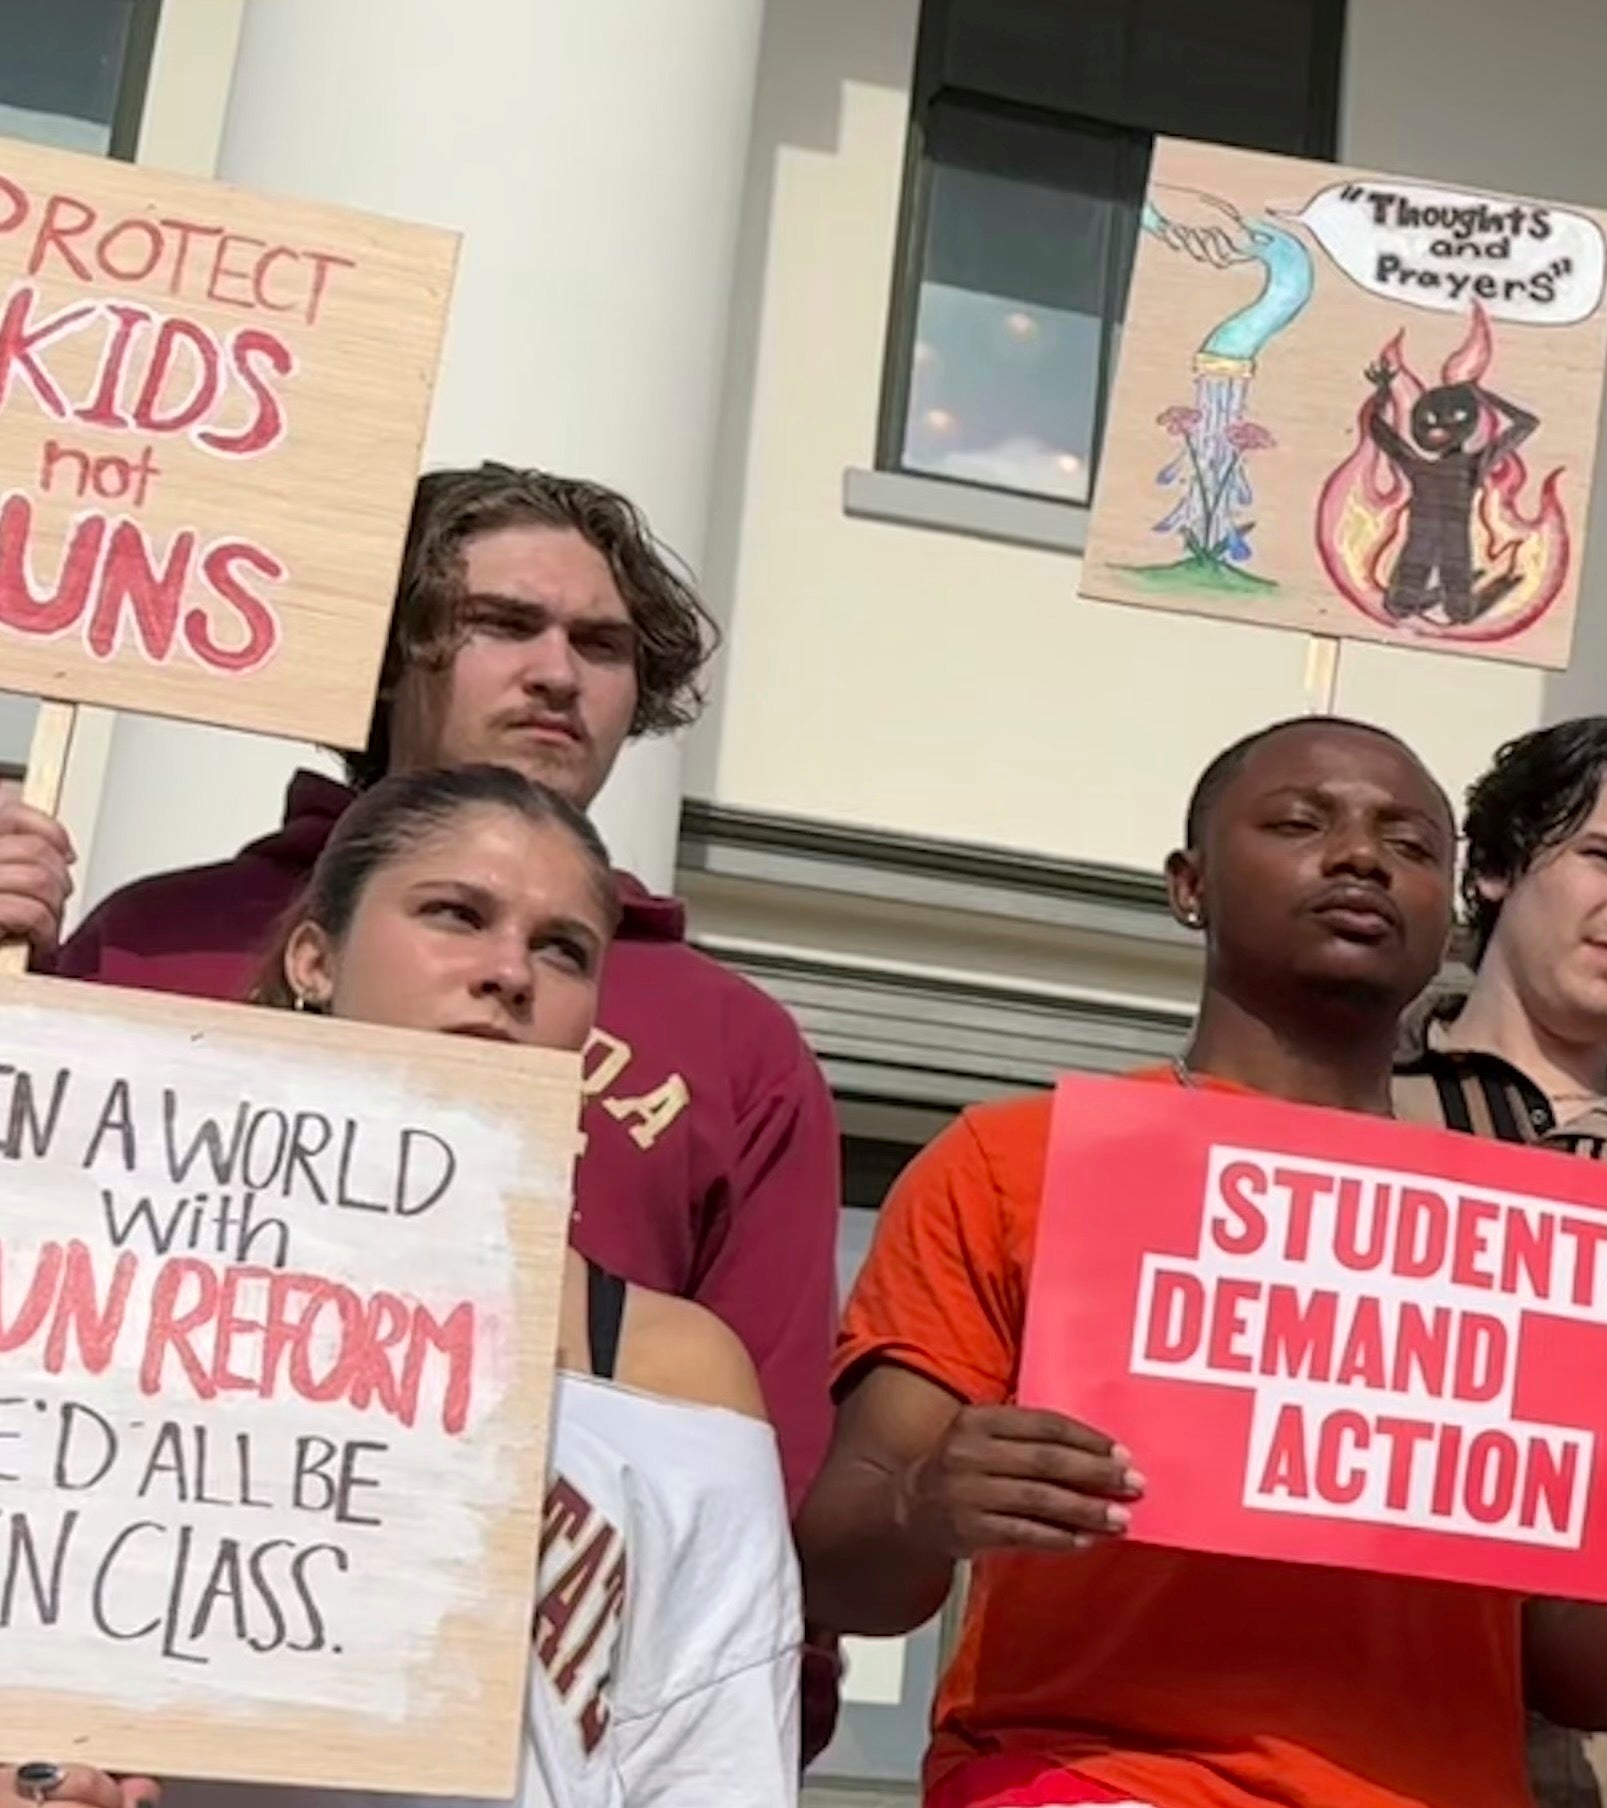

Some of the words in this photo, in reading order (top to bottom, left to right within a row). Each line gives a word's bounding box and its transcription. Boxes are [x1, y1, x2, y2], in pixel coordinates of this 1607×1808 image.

[1429, 236, 1511, 260] and
[0, 288, 293, 454] KIDS
[40, 440, 160, 507] not
[83, 1078, 136, 1172] A
[164, 1089, 456, 1215] WORLD
[139, 1257, 477, 1435] REFORM
[1143, 1267, 1510, 1404] DEMAND
[139, 1421, 271, 1508] ALL
[293, 1434, 389, 1525] BE
[1258, 1404, 1579, 1533] ACTION
[93, 1522, 347, 1662] CLASS.
